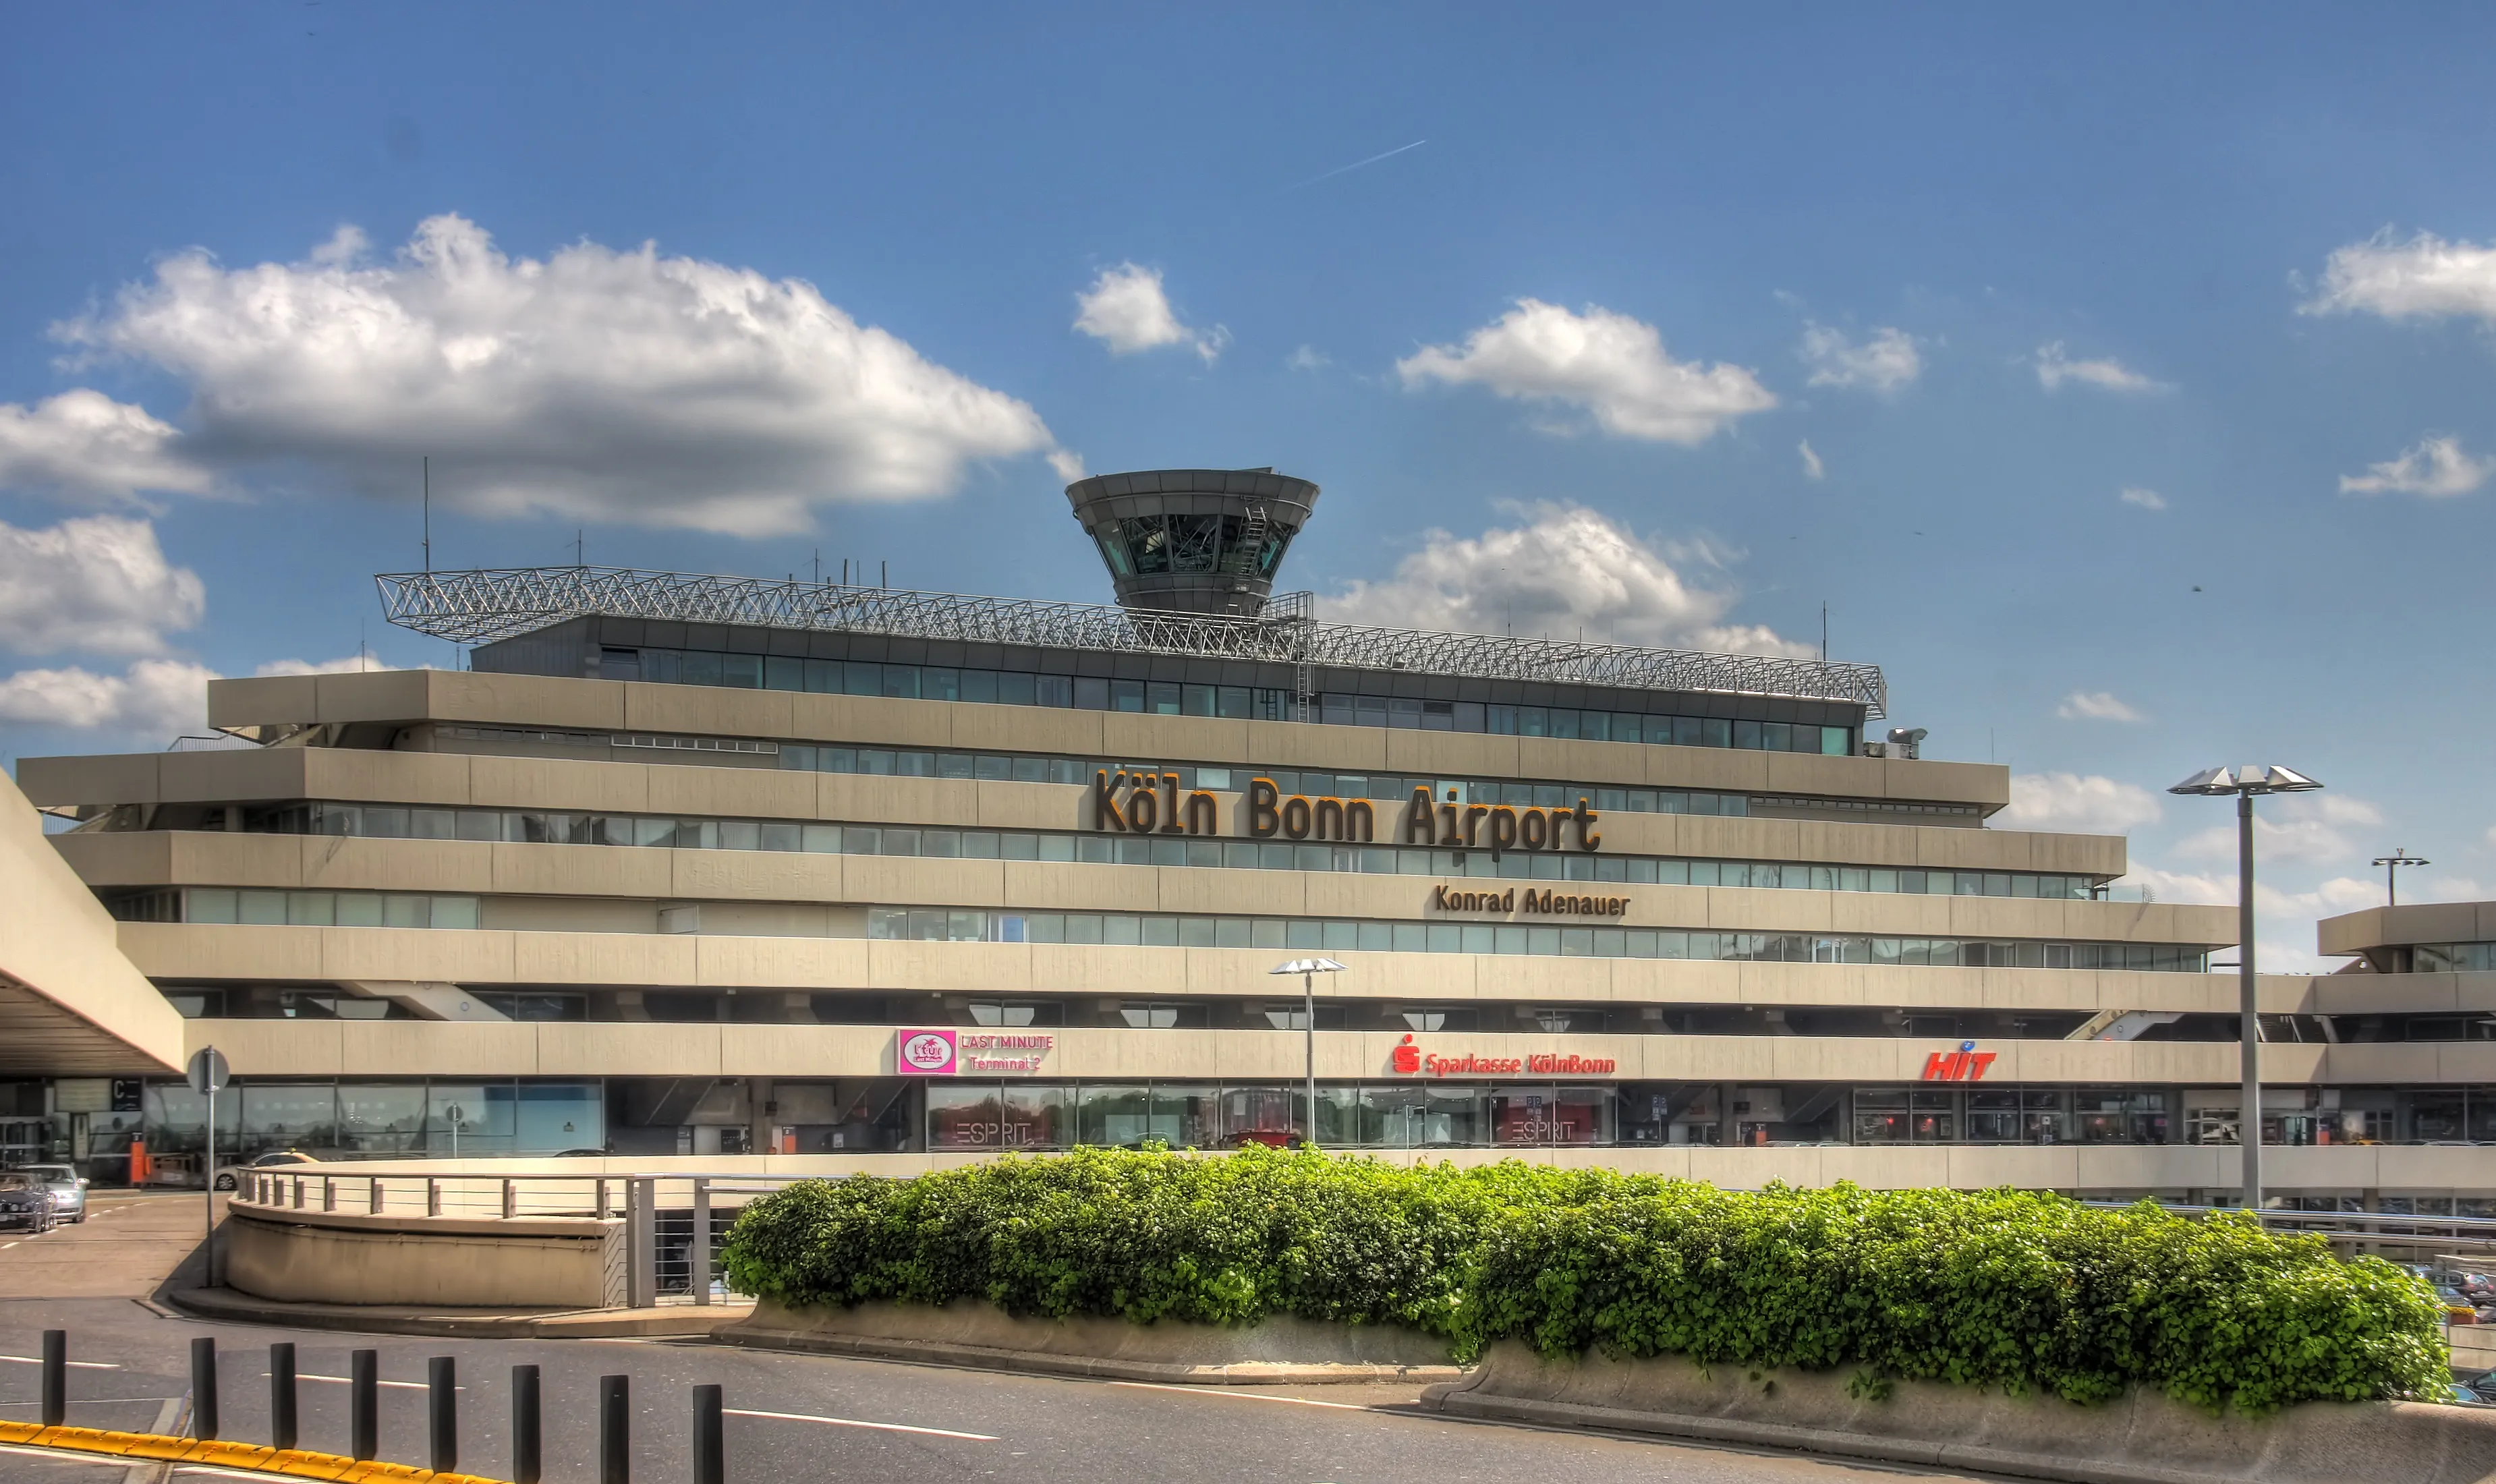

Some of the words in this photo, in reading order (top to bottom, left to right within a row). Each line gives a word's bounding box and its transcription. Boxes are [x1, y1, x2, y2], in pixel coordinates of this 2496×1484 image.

[1096, 769, 1218, 835] Köln
[1250, 777, 1375, 843] Bonn
[1407, 785, 1601, 863] Airport
[1435, 884, 1514, 912] Konrad
[1525, 887, 1631, 916] Adenauer
[960, 1035, 997, 1048] LAST
[999, 1035, 1054, 1049] MINUTE
[969, 1056, 1029, 1071] Terminal
[1034, 1057, 1041, 1071] 2
[1425, 1053, 1522, 1077] Sparkasse
[1527, 1053, 1616, 1073] KölnBonn
[113, 1080, 125, 1099] C
[957, 1122, 1031, 1144] ESPRIT
[1512, 1121, 1576, 1140] ESPRIT
